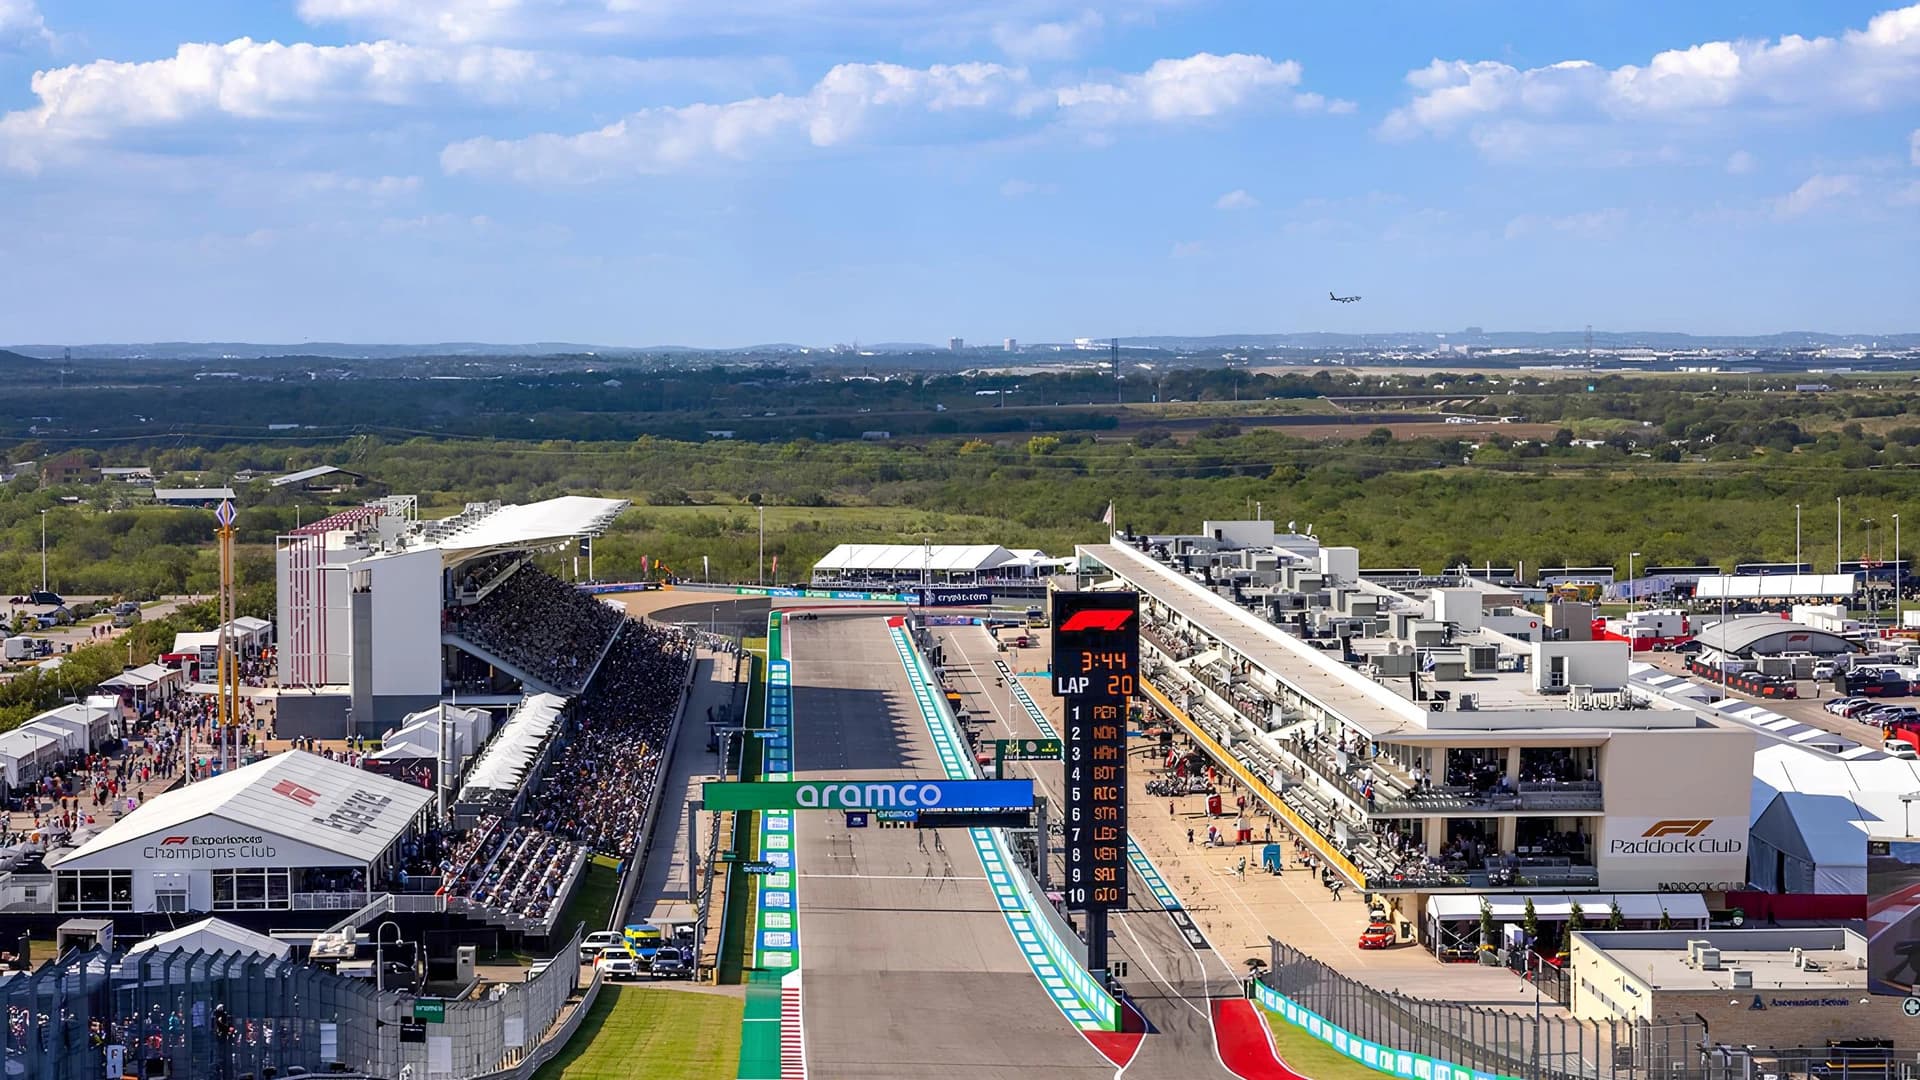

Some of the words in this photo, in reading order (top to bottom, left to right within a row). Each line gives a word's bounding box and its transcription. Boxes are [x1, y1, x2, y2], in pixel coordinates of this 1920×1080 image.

[1081, 652, 1126, 672] 3:44
[1058, 677, 1089, 694] LAP
[1108, 675, 1133, 695] 20
[1072, 705, 1080, 721] 1
[1071, 726, 1081, 741] 2
[1071, 746, 1081, 761] 3
[1071, 766, 1081, 782] 4
[1093, 765, 1117, 780] BOT
[796, 784, 942, 807] aramco
[1072, 787, 1081, 801] 5
[1093, 786, 1118, 801] RIC
[1072, 807, 1081, 822] 6
[1071, 827, 1081, 842] 7
[143, 846, 236, 860] Champions
[240, 846, 276, 858] Club
[1611, 840, 1696, 853] Paddock
[1699, 838, 1742, 853] Club
[1072, 847, 1081, 862] 8
[1072, 868, 1081, 883] 9
[1094, 867, 1117, 882] SAI
[1068, 888, 1085, 903] 10
